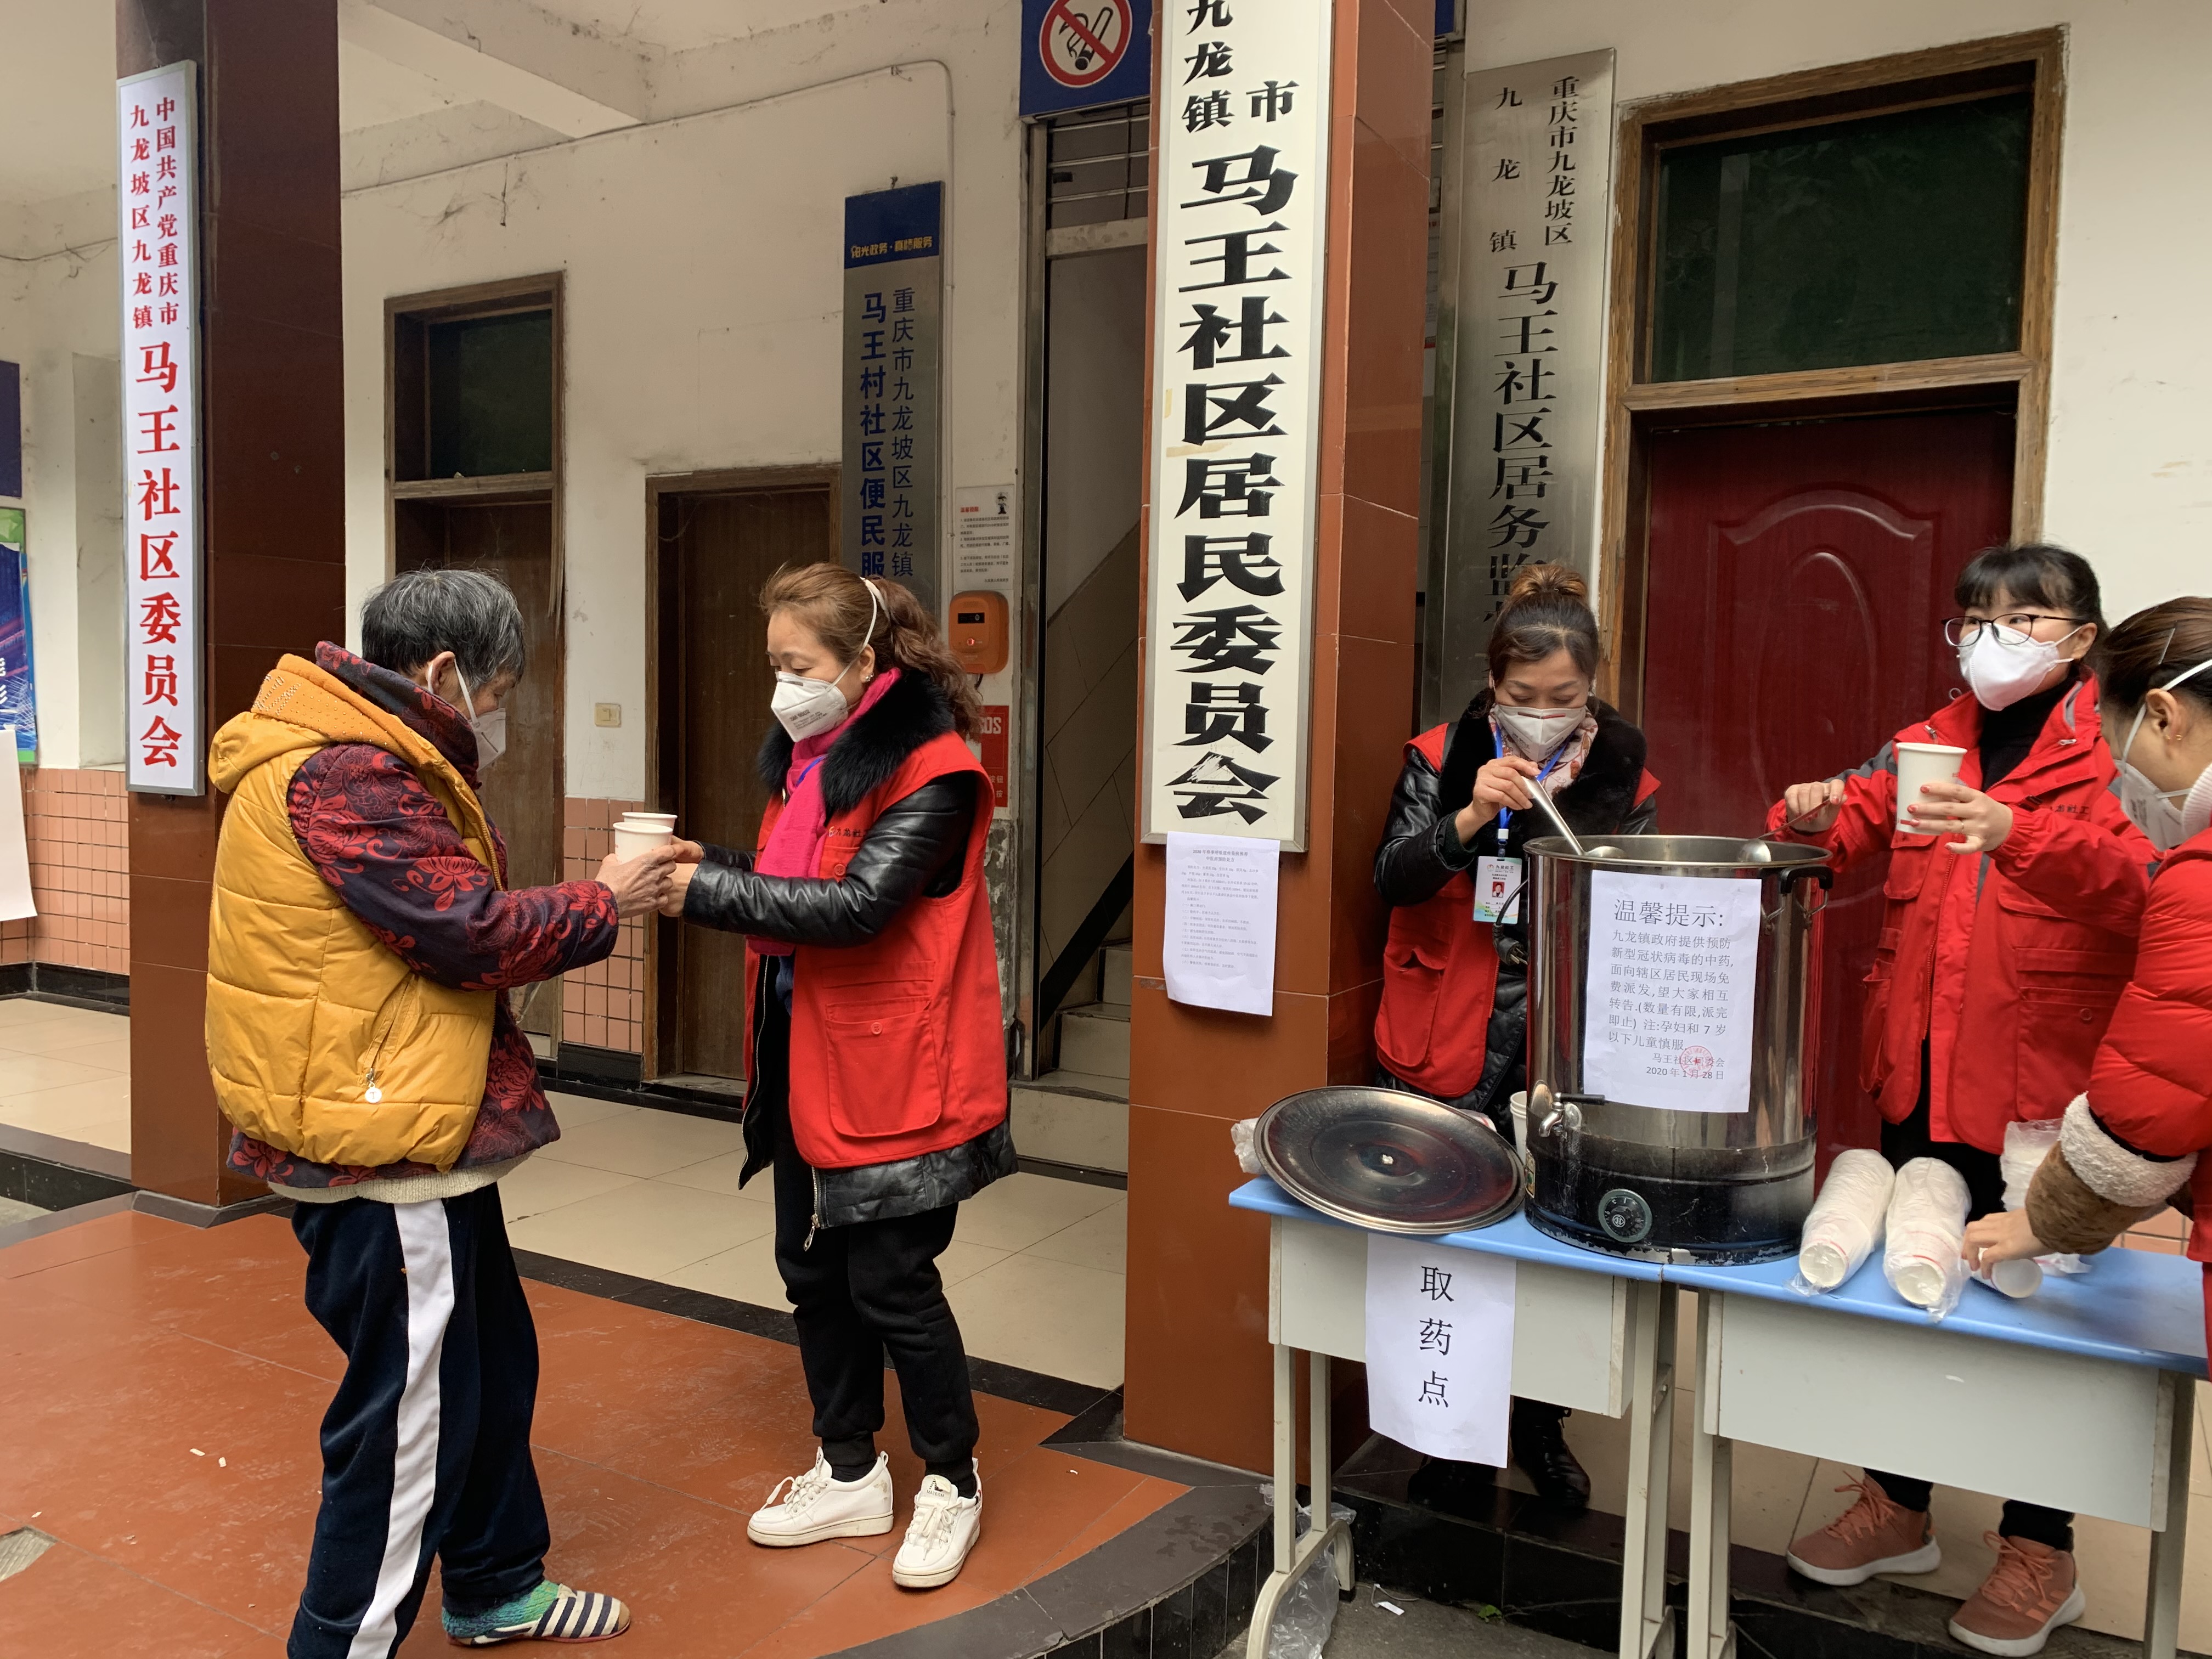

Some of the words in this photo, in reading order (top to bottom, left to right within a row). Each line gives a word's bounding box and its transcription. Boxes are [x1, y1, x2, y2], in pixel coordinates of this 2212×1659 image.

[1182, 0, 1235, 133] 九龙镇
[1246, 80, 1300, 122] 市
[130, 104, 153, 329] 九龙坡区九龙镇
[156, 97, 179, 325] 中国共产党重庆市
[1544, 76, 1579, 246] 重庆市九龙坡区
[892, 287, 915, 577] 重庆市九龙坡区九龙镇
[1163, 144, 1299, 825] 马王社区居民委员会
[1483, 261, 1559, 622] 马王社区居务监
[136, 341, 183, 768] 马王社区委员会
[1611, 963, 1730, 984] 面向辖区居民现场免
[1612, 929, 1731, 949] 九龙镇政府提供预防
[1652, 1053, 1725, 1068] 马王社区居委会
[1418, 1265, 1454, 1408] 取药点
